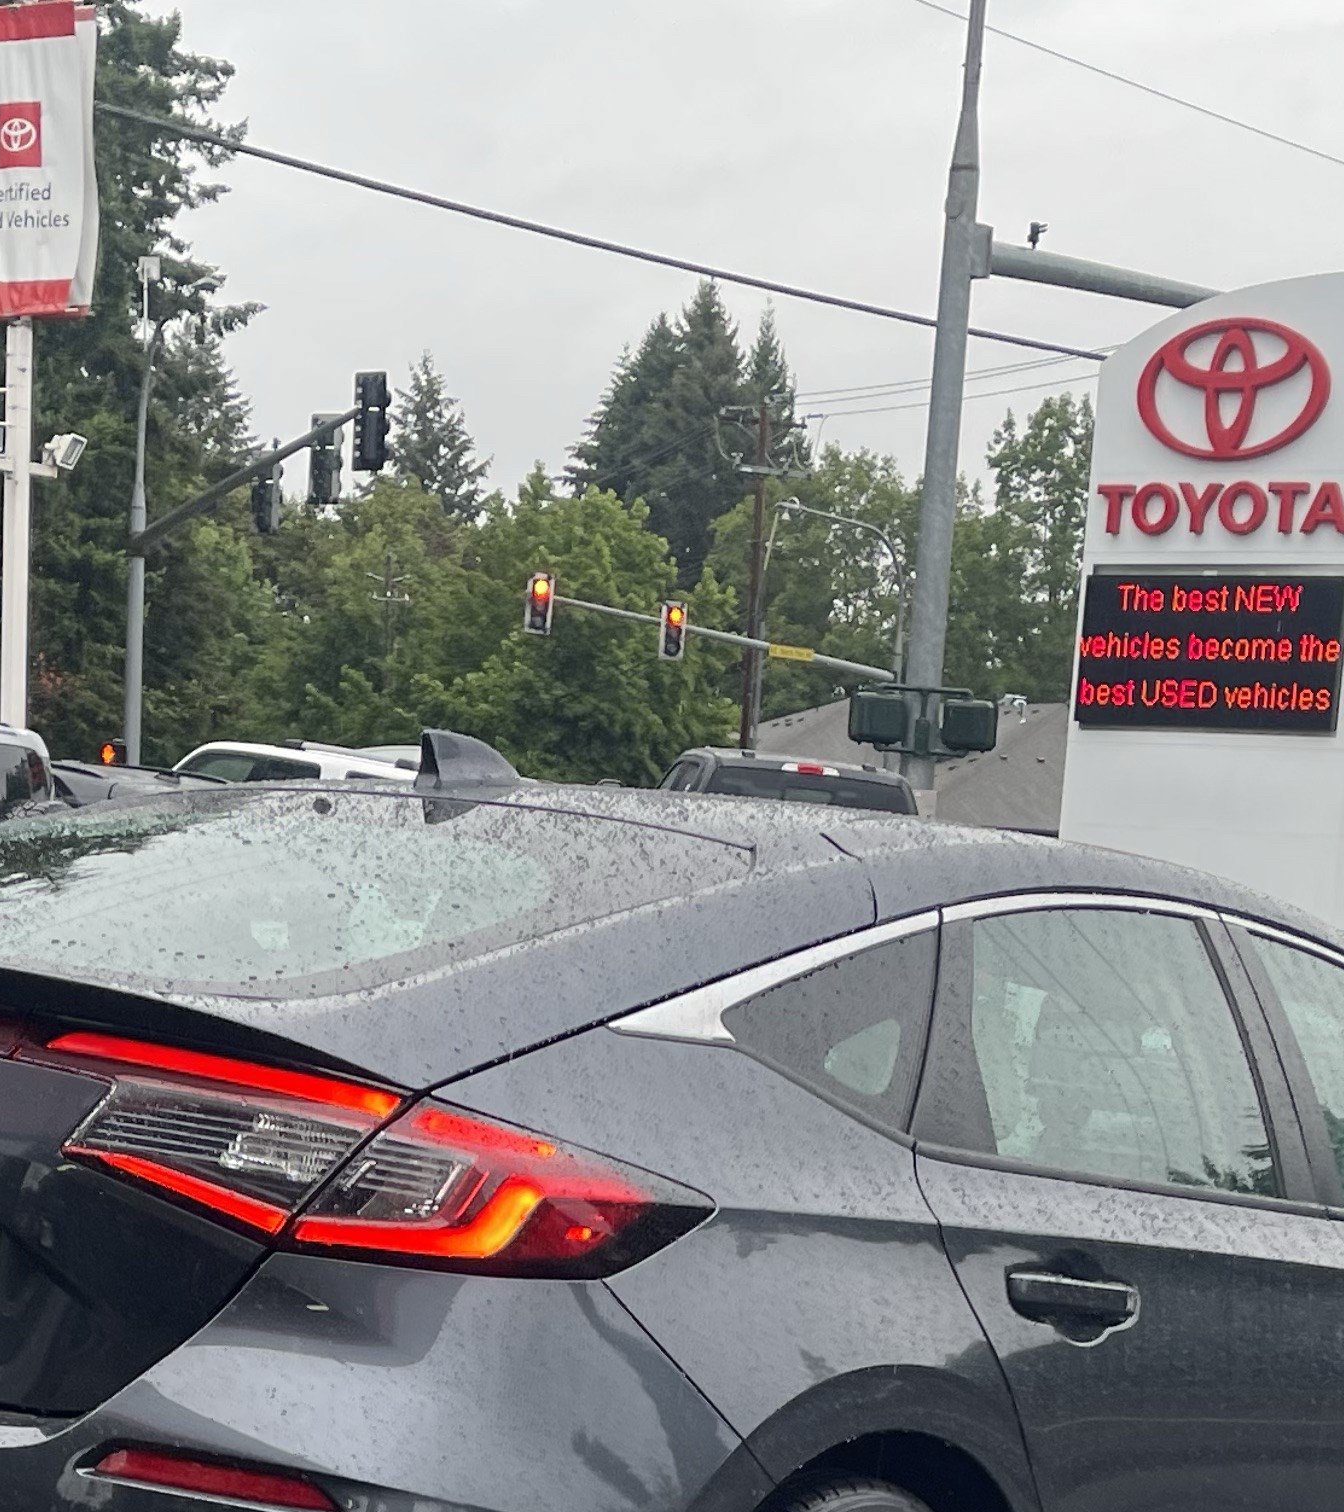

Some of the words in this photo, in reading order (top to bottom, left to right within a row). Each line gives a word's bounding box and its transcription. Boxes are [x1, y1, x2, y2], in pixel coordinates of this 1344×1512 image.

[6, 209, 70, 228] Vehicles
[1117, 582, 1165, 613] The
[1172, 584, 1229, 613] best
[1233, 585, 1304, 613] NEW
[1080, 631, 1181, 660] vehicles
[1188, 632, 1293, 662] become
[1299, 634, 1341, 663] the
[1079, 677, 1136, 706] best
[1140, 679, 1218, 710] USED
[1223, 682, 1332, 712] vehicles
